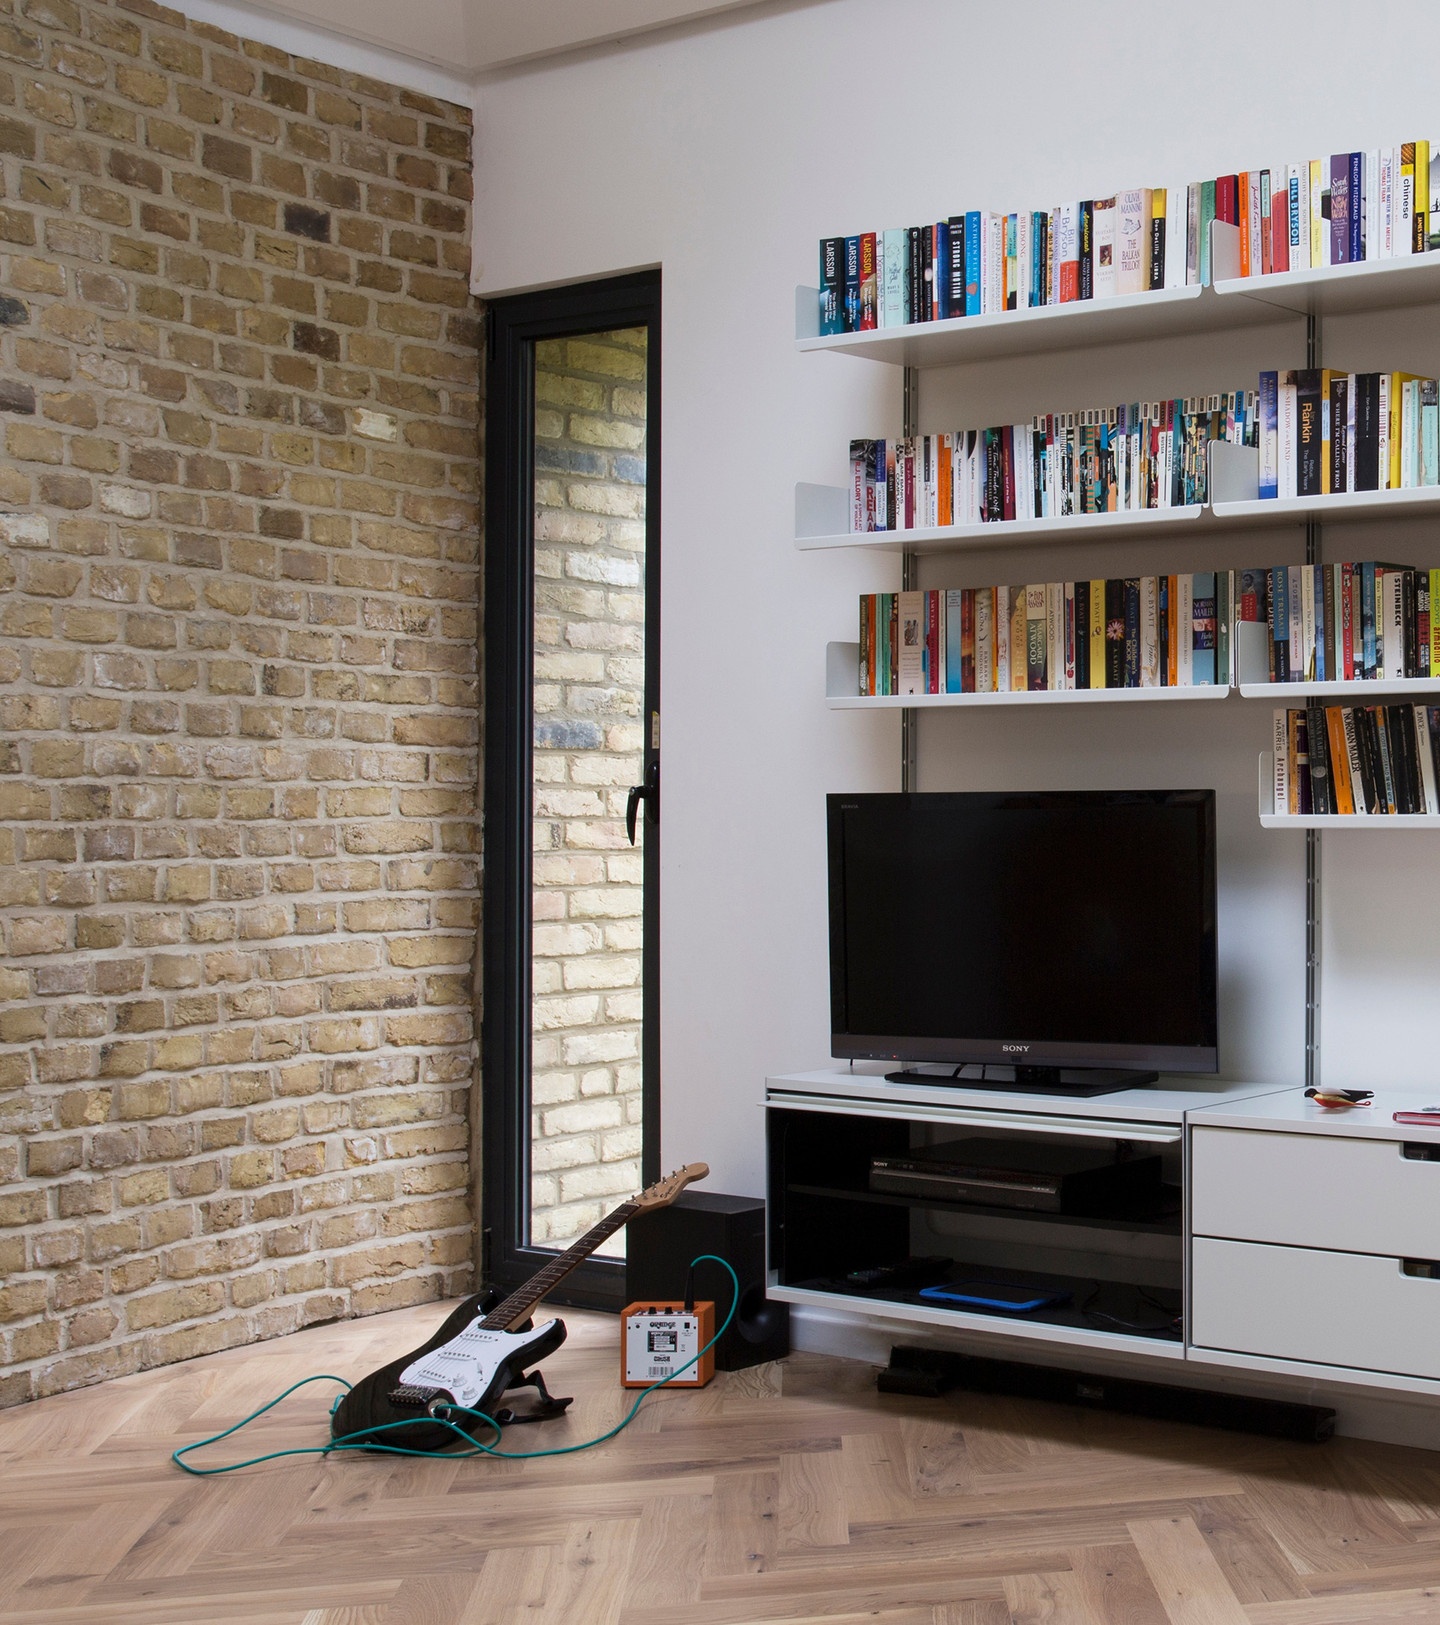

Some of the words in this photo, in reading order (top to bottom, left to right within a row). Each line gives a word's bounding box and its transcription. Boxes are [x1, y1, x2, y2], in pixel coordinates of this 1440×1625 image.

[1402, 178, 1411, 219] chinese
[1060, 217, 1070, 257] Bryson
[1291, 203, 1299, 245] BRYSON
[826, 241, 834, 277] LARSSON
[863, 238, 872, 274] LARSSON
[952, 241, 960, 268] STRONG
[952, 271, 961, 299] MOTION
[1302, 403, 1312, 443] Rankin
[1343, 713, 1356, 744] NORMAN
[1348, 745, 1360, 773] MAILER
[1276, 758, 1285, 800] Archangel
